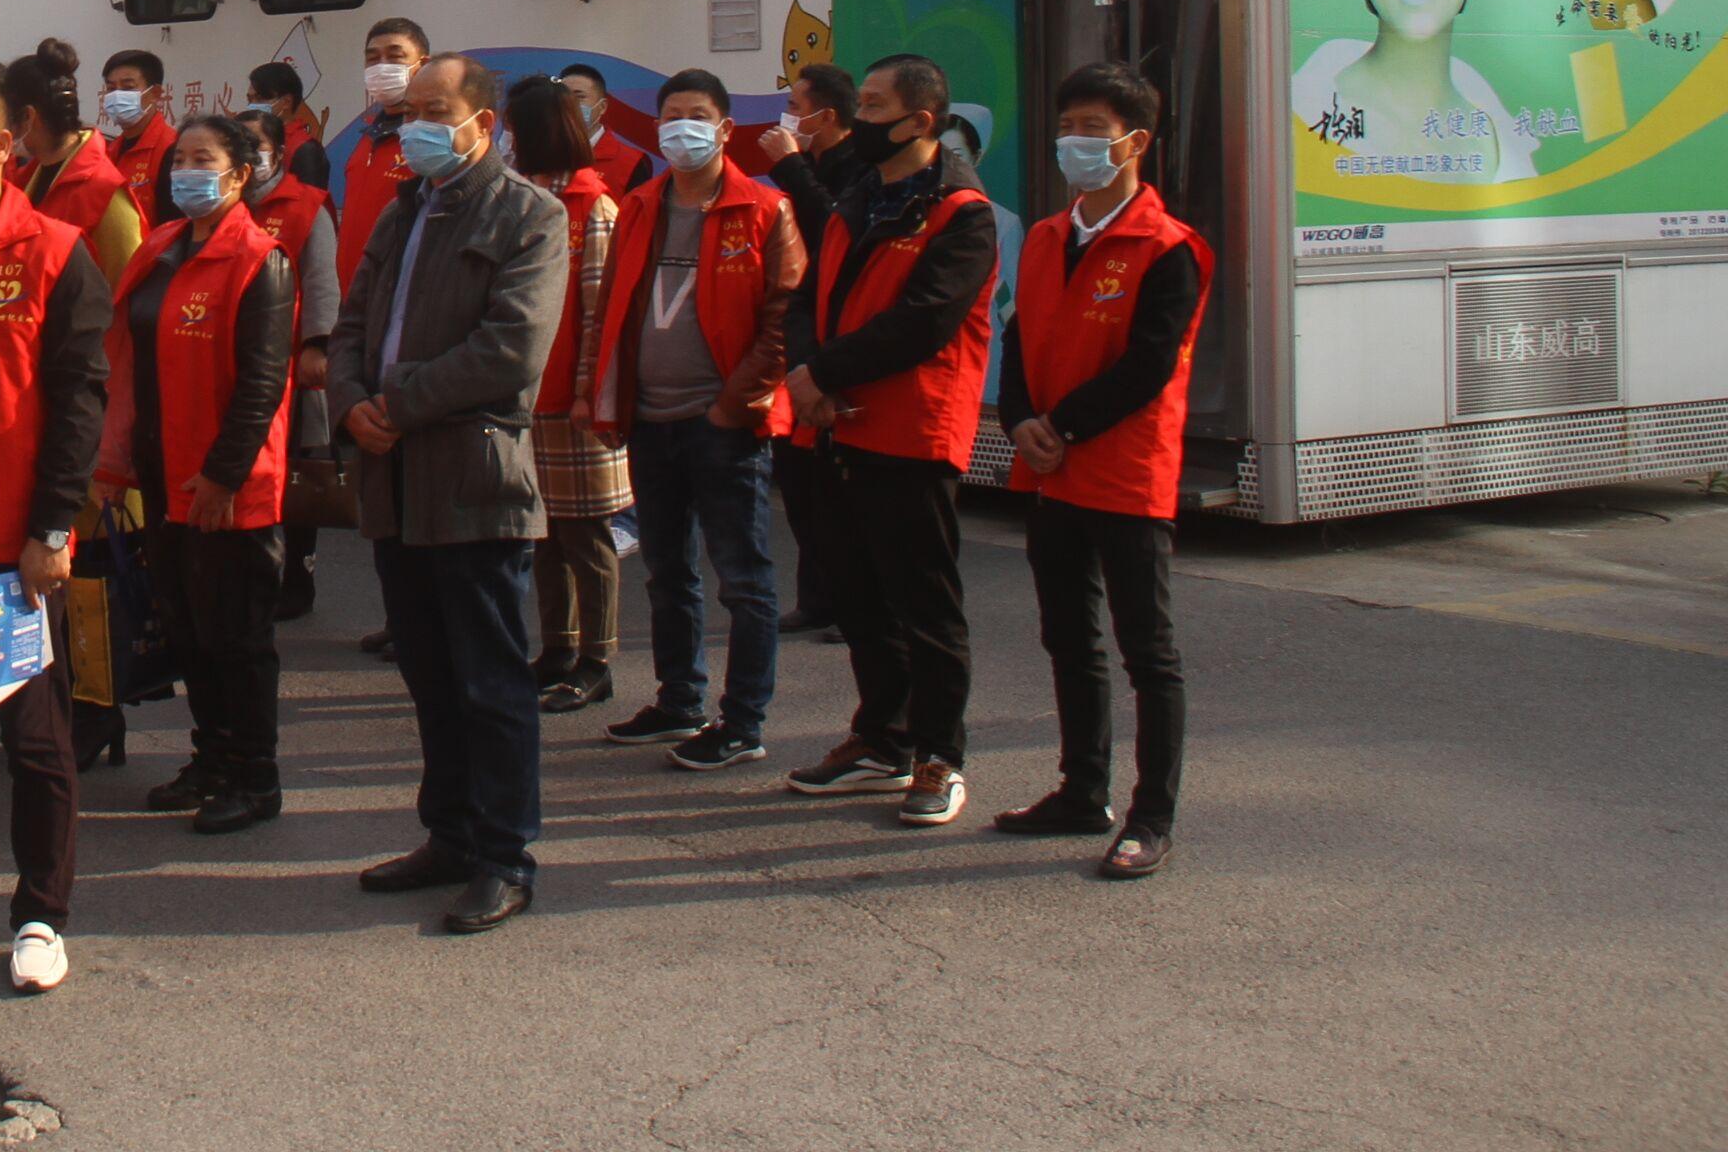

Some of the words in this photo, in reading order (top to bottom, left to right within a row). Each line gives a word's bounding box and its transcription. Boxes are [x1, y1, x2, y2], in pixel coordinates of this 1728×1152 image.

[1422, 109, 1490, 139] 我健康
[1513, 107, 1580, 138] 我献血
[1334, 154, 1483, 176] 中国无偿献血形象大使
[1475, 318, 1601, 361] 山东威高
